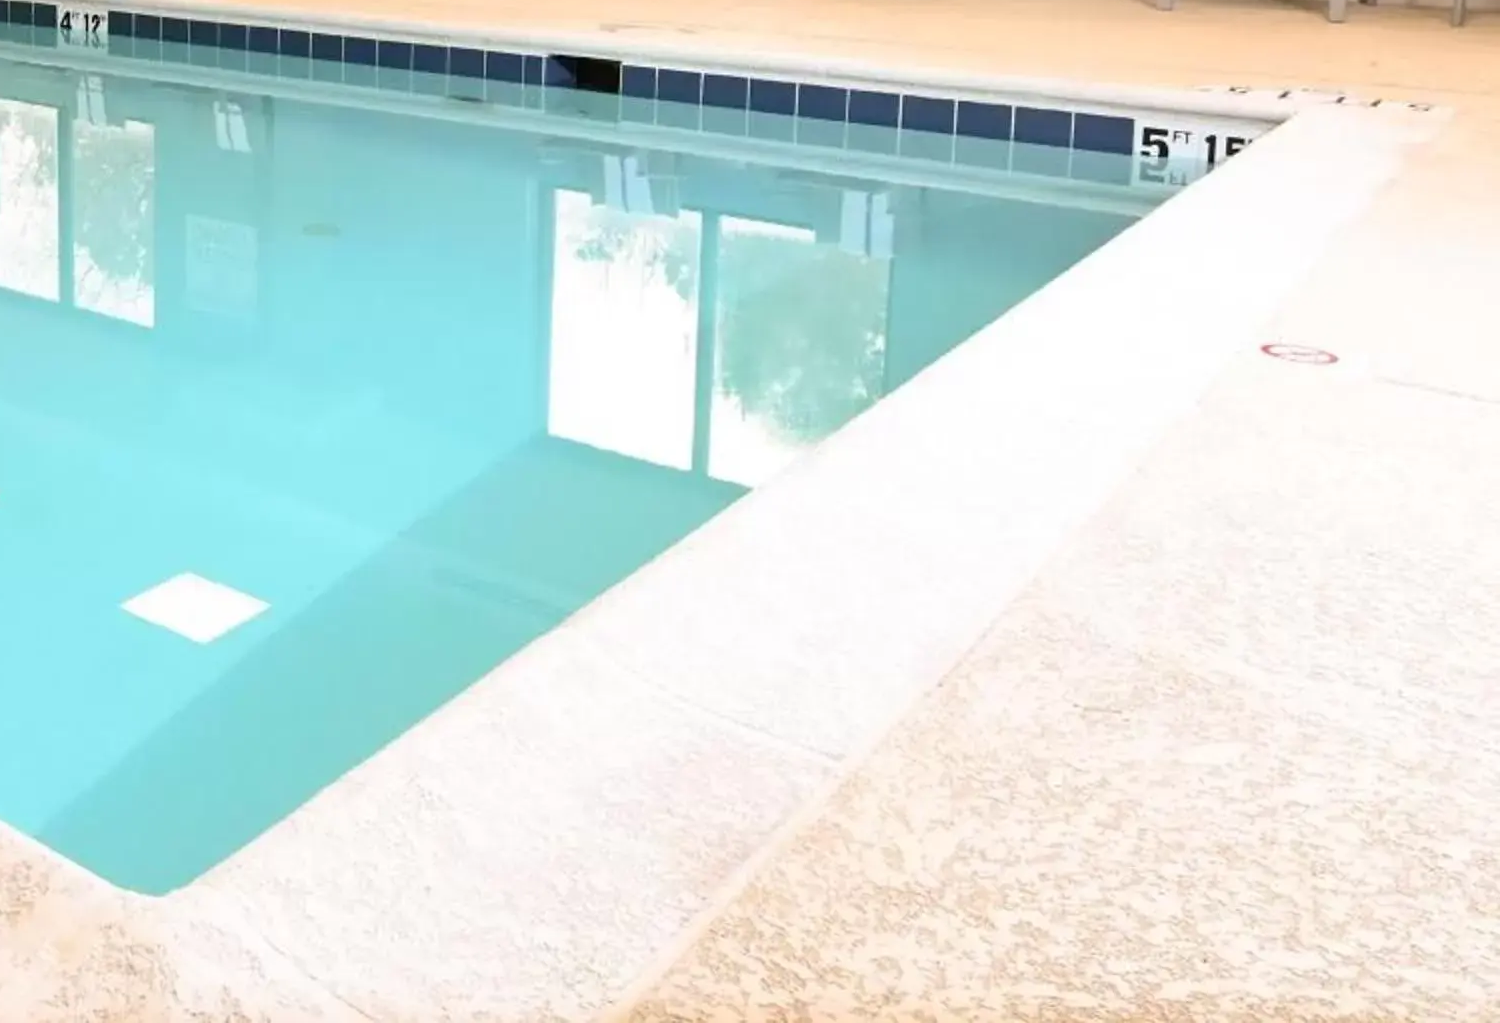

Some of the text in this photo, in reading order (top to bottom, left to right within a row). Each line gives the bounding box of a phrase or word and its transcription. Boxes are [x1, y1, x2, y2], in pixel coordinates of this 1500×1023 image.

[60, 10, 72, 30] 4
[1140, 126, 1169, 159] 5
[1172, 130, 1193, 145] FT
